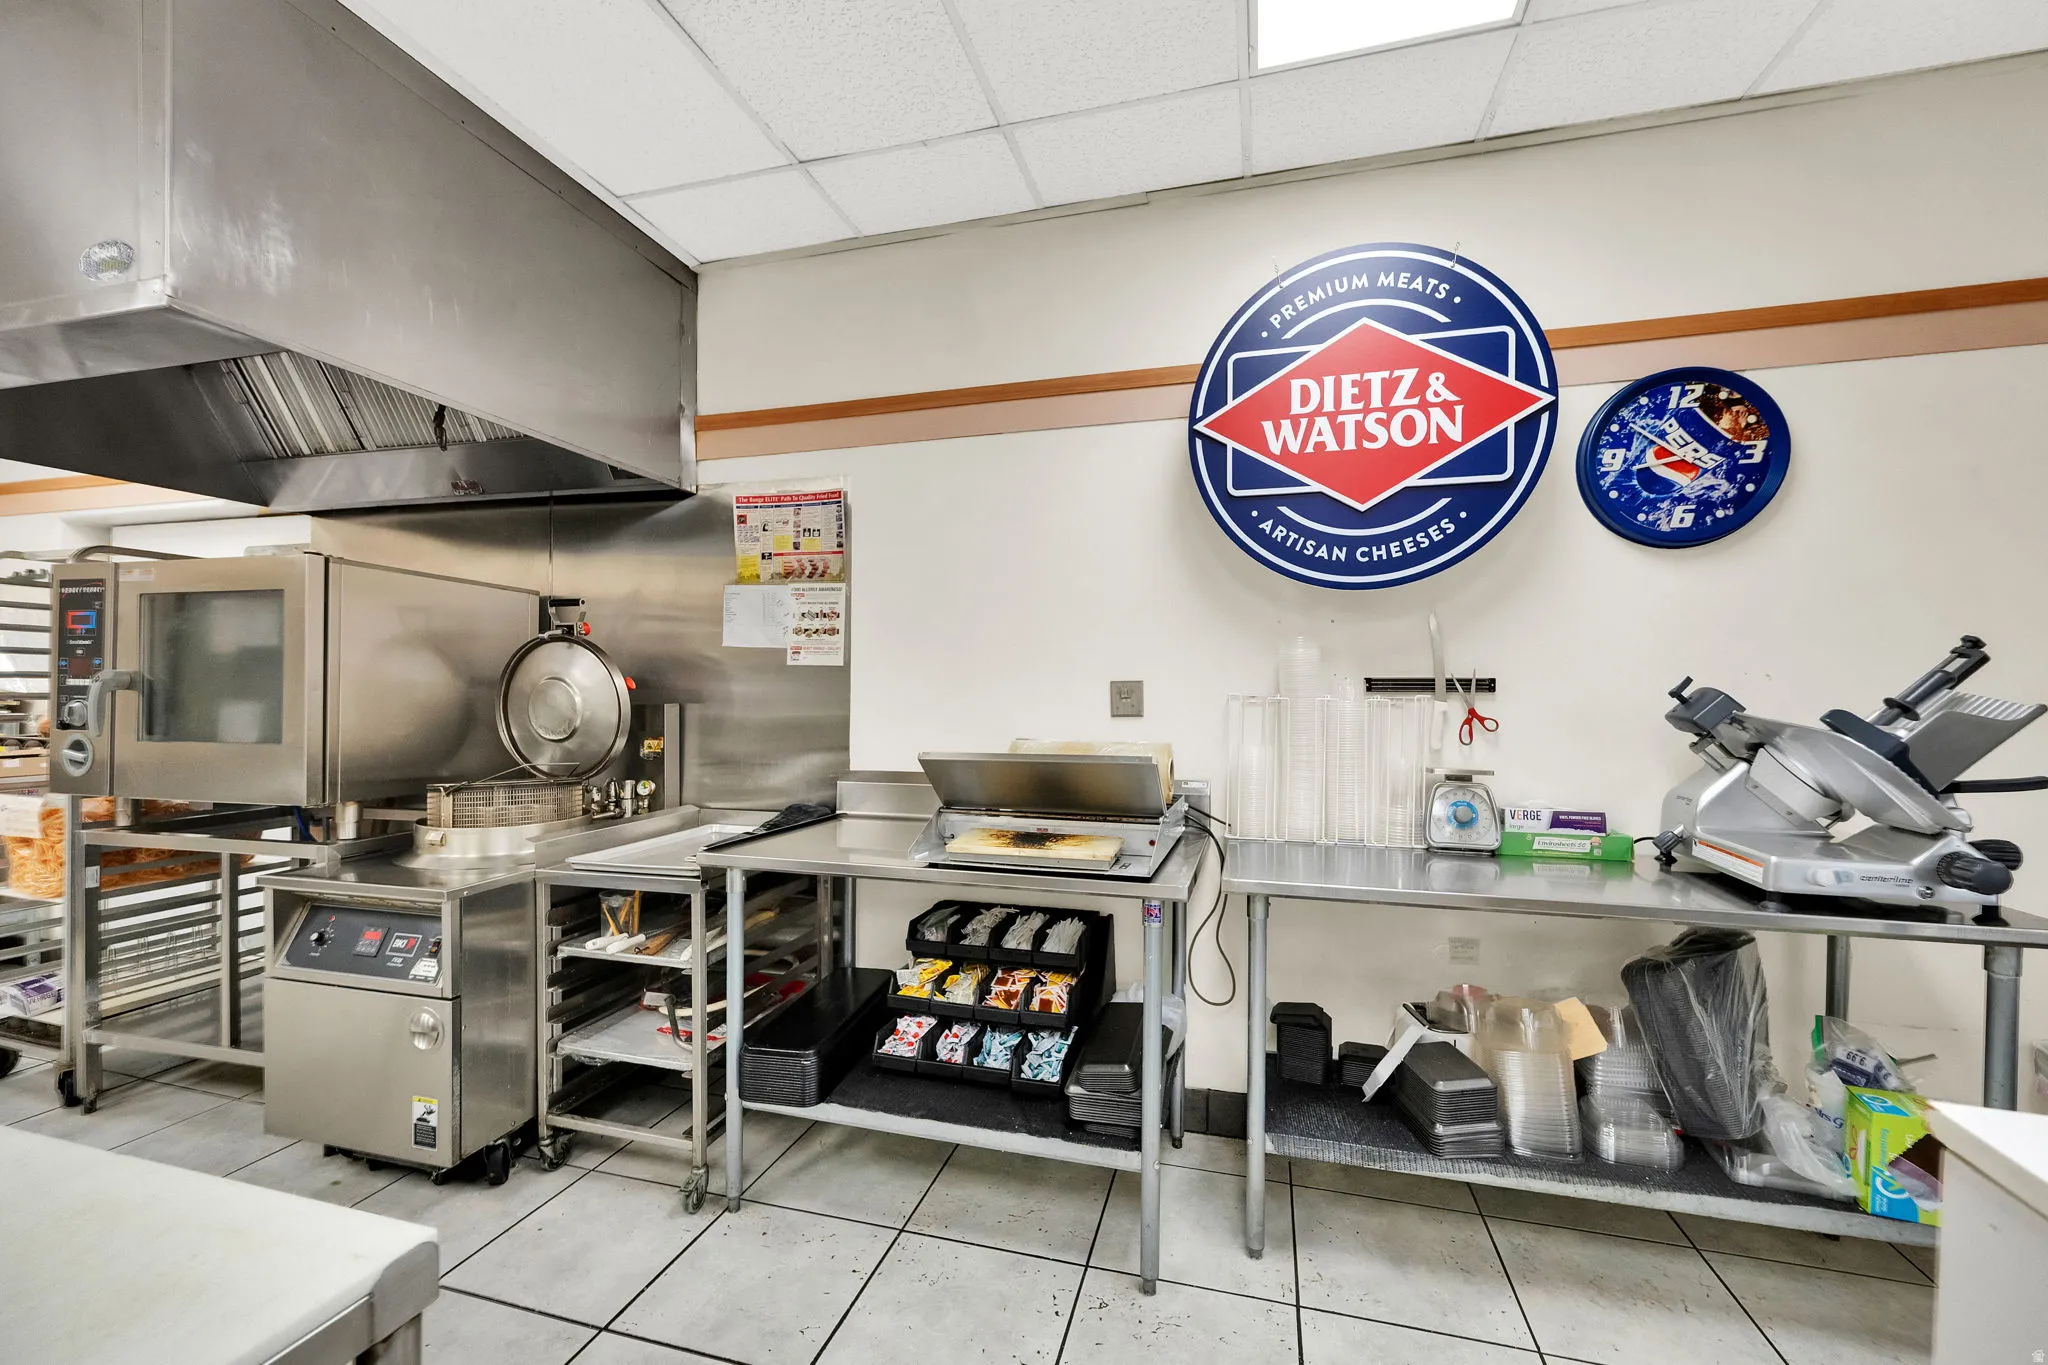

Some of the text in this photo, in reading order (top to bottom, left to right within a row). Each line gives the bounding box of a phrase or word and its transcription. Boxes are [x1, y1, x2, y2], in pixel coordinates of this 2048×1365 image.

[1269, 271, 1451, 329] PREMIUM MEATS
[1289, 368, 1461, 416] DIETZ &
[1667, 383, 1705, 410] 12
[1260, 404, 1465, 456] WATSON
[1601, 448, 1626, 472] 9
[1738, 439, 1768, 465] 3
[799, 493, 816, 501] Quality
[1669, 504, 1697, 529] 6
[1258, 517, 1456, 563] ARTISAN CHEESES
[1509, 809, 1542, 821] VERGE
